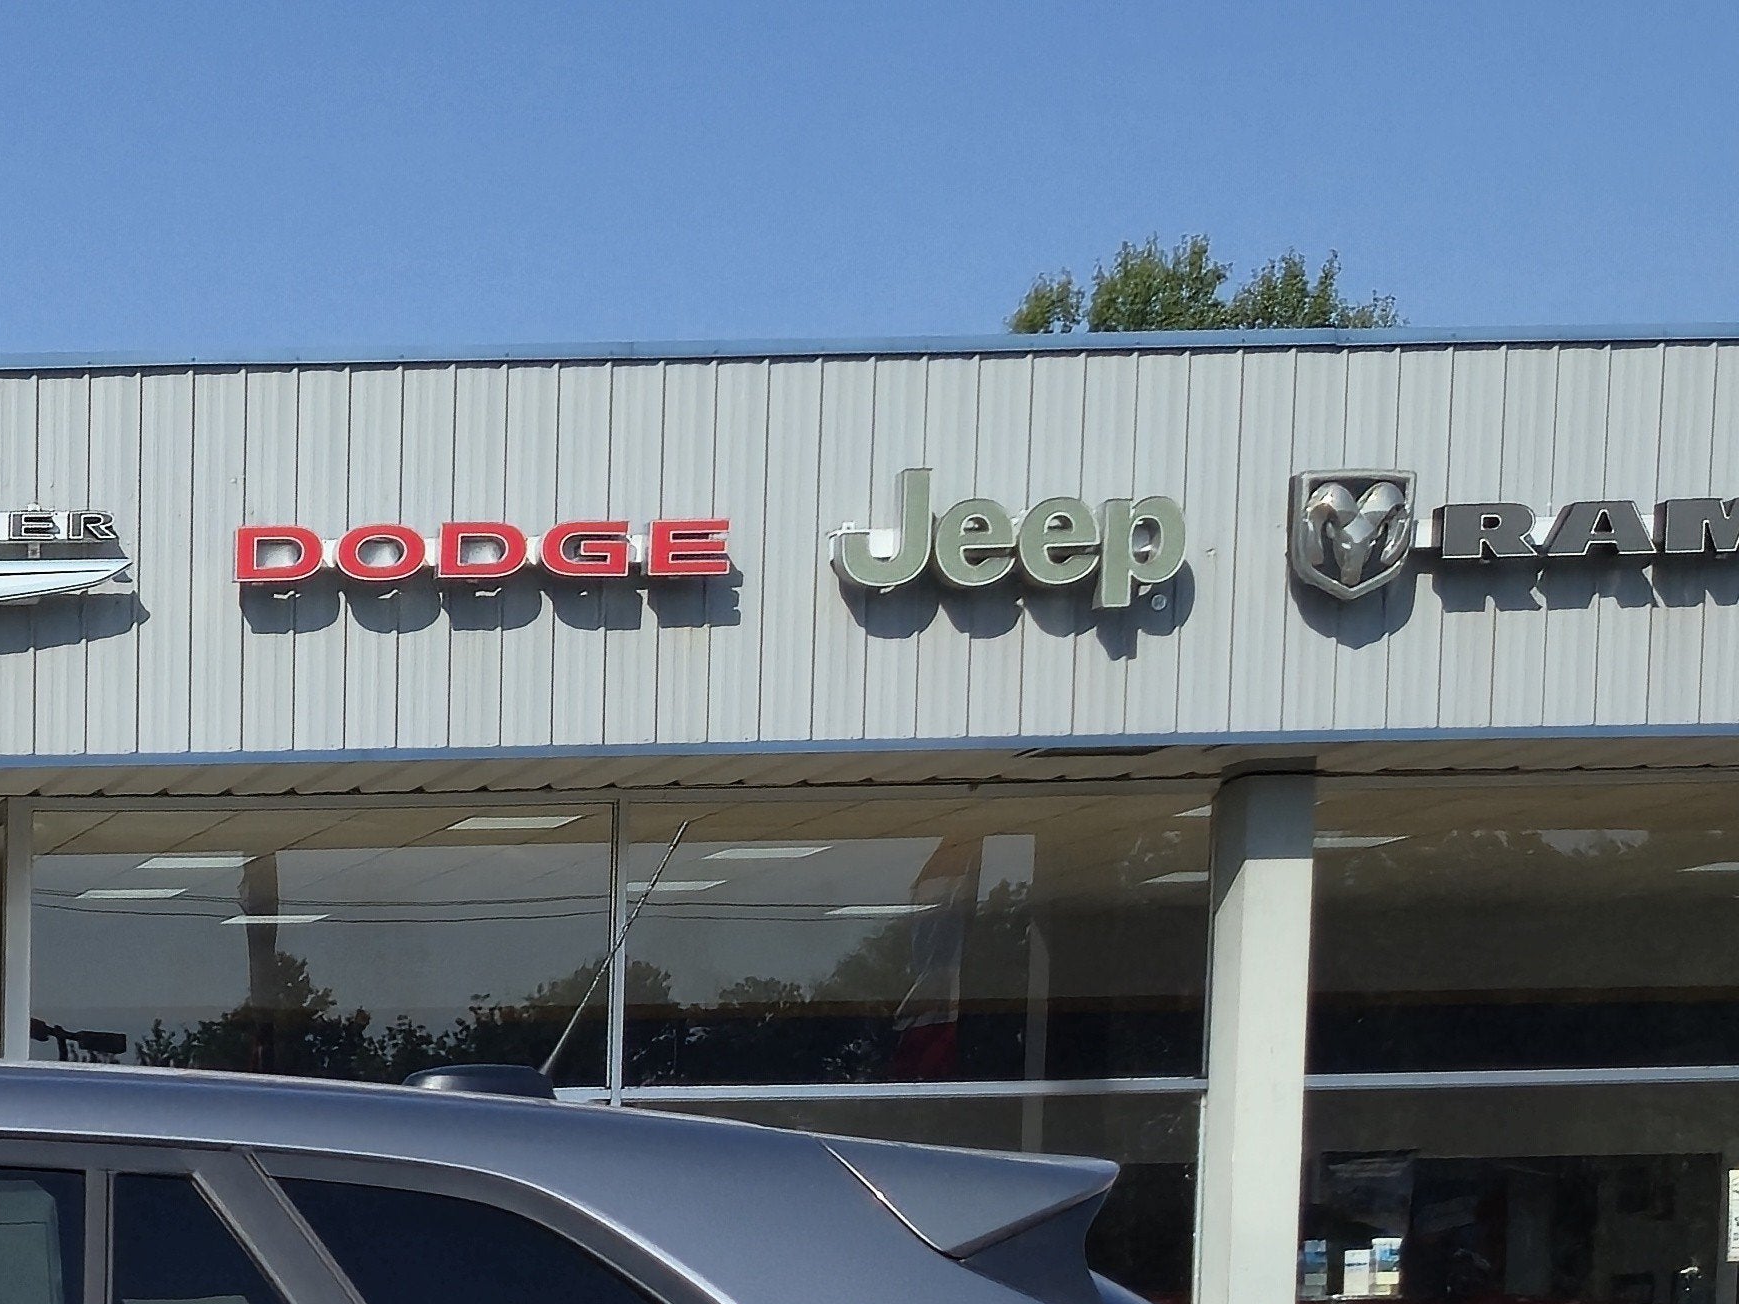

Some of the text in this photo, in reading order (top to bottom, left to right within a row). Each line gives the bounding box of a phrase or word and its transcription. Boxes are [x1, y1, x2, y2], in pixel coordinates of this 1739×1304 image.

[233, 518, 731, 582] DODGE
[829, 467, 1186, 609] Jeep
[1434, 497, 1739, 559] RAM
